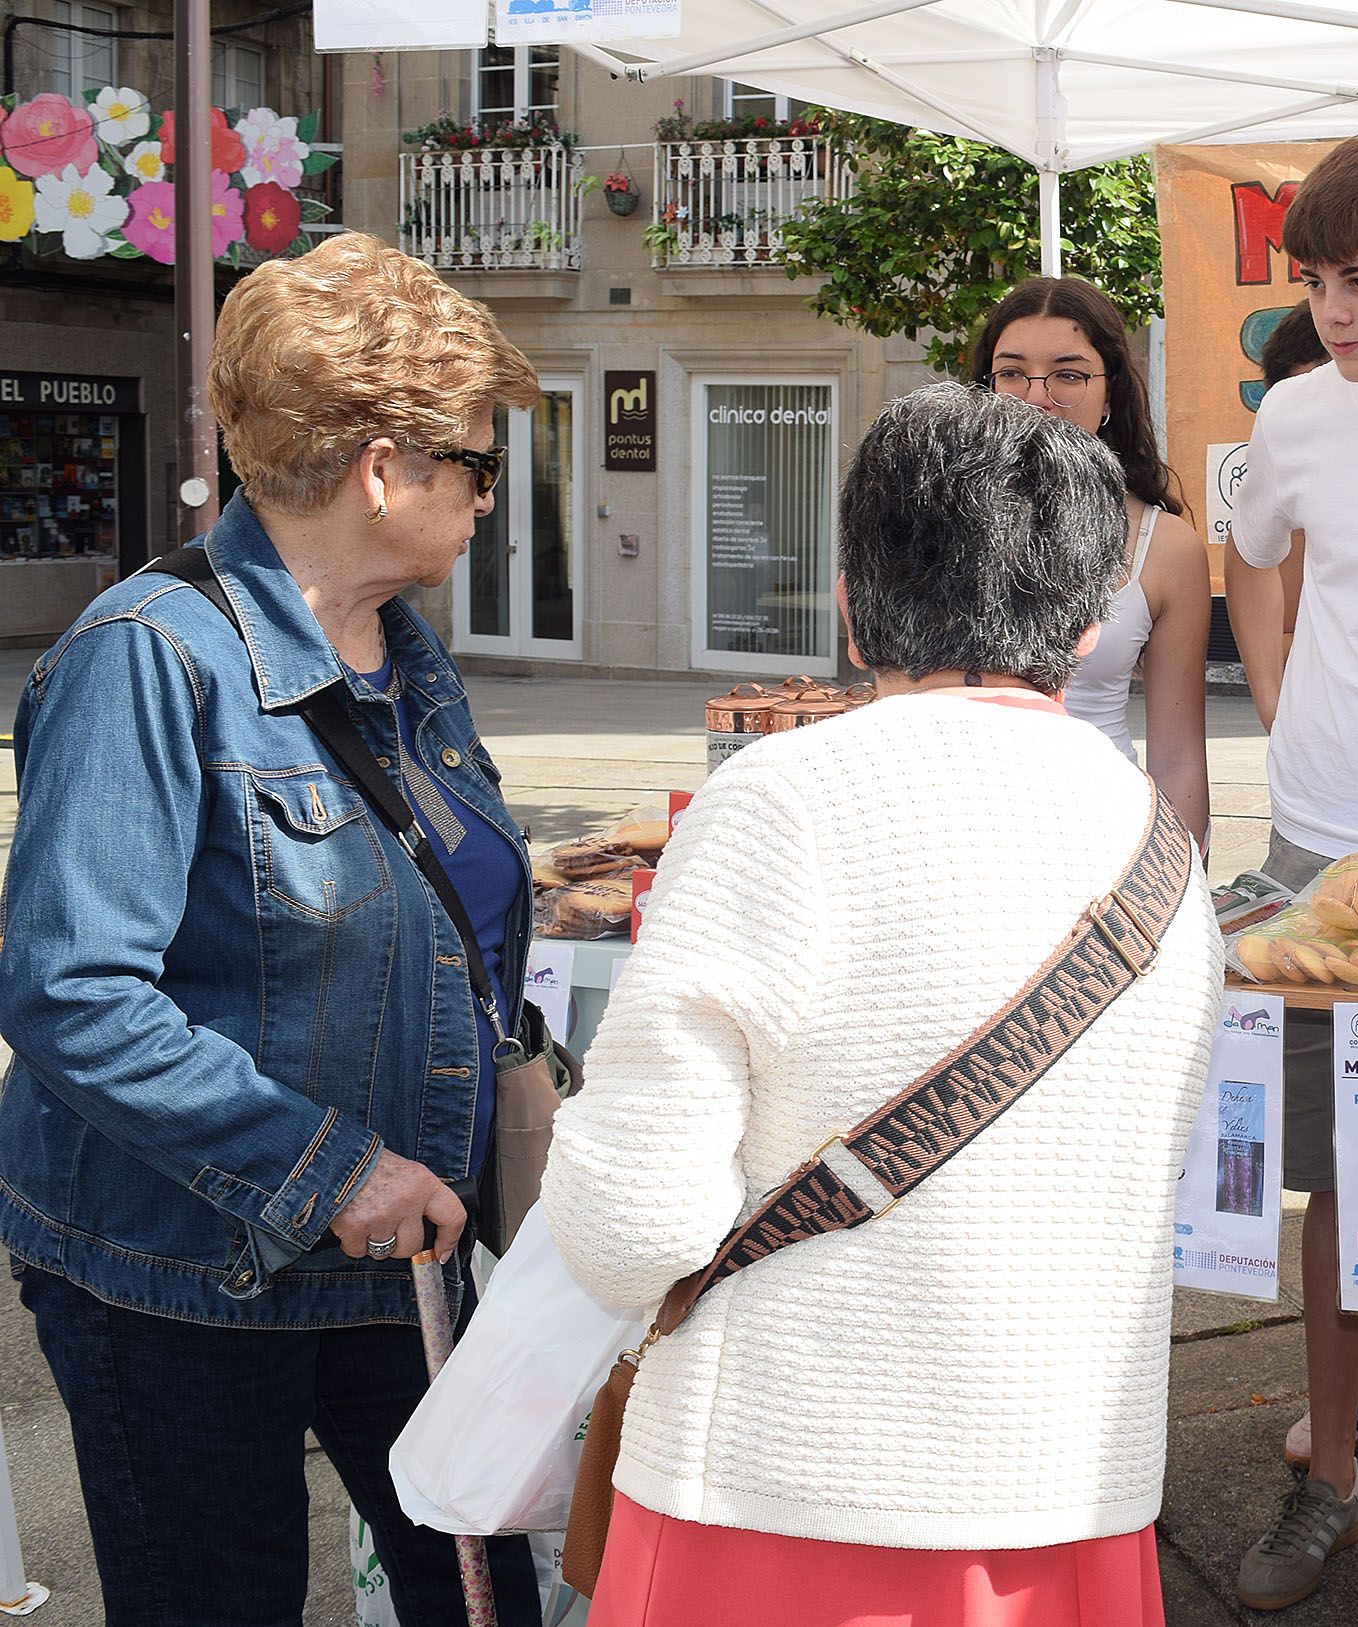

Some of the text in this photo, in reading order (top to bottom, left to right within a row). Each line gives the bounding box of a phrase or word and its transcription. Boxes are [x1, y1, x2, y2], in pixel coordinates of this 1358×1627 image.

[1, 379, 116, 405] EL PUEBLO
[770, 405, 832, 425] dental
[608, 433, 652, 446] pontus
[610, 448, 650, 459] dental
[1219, 1254, 1276, 1269] DEPUTACIÓN
[1219, 1264, 1276, 1277] PONTEVEDRA
